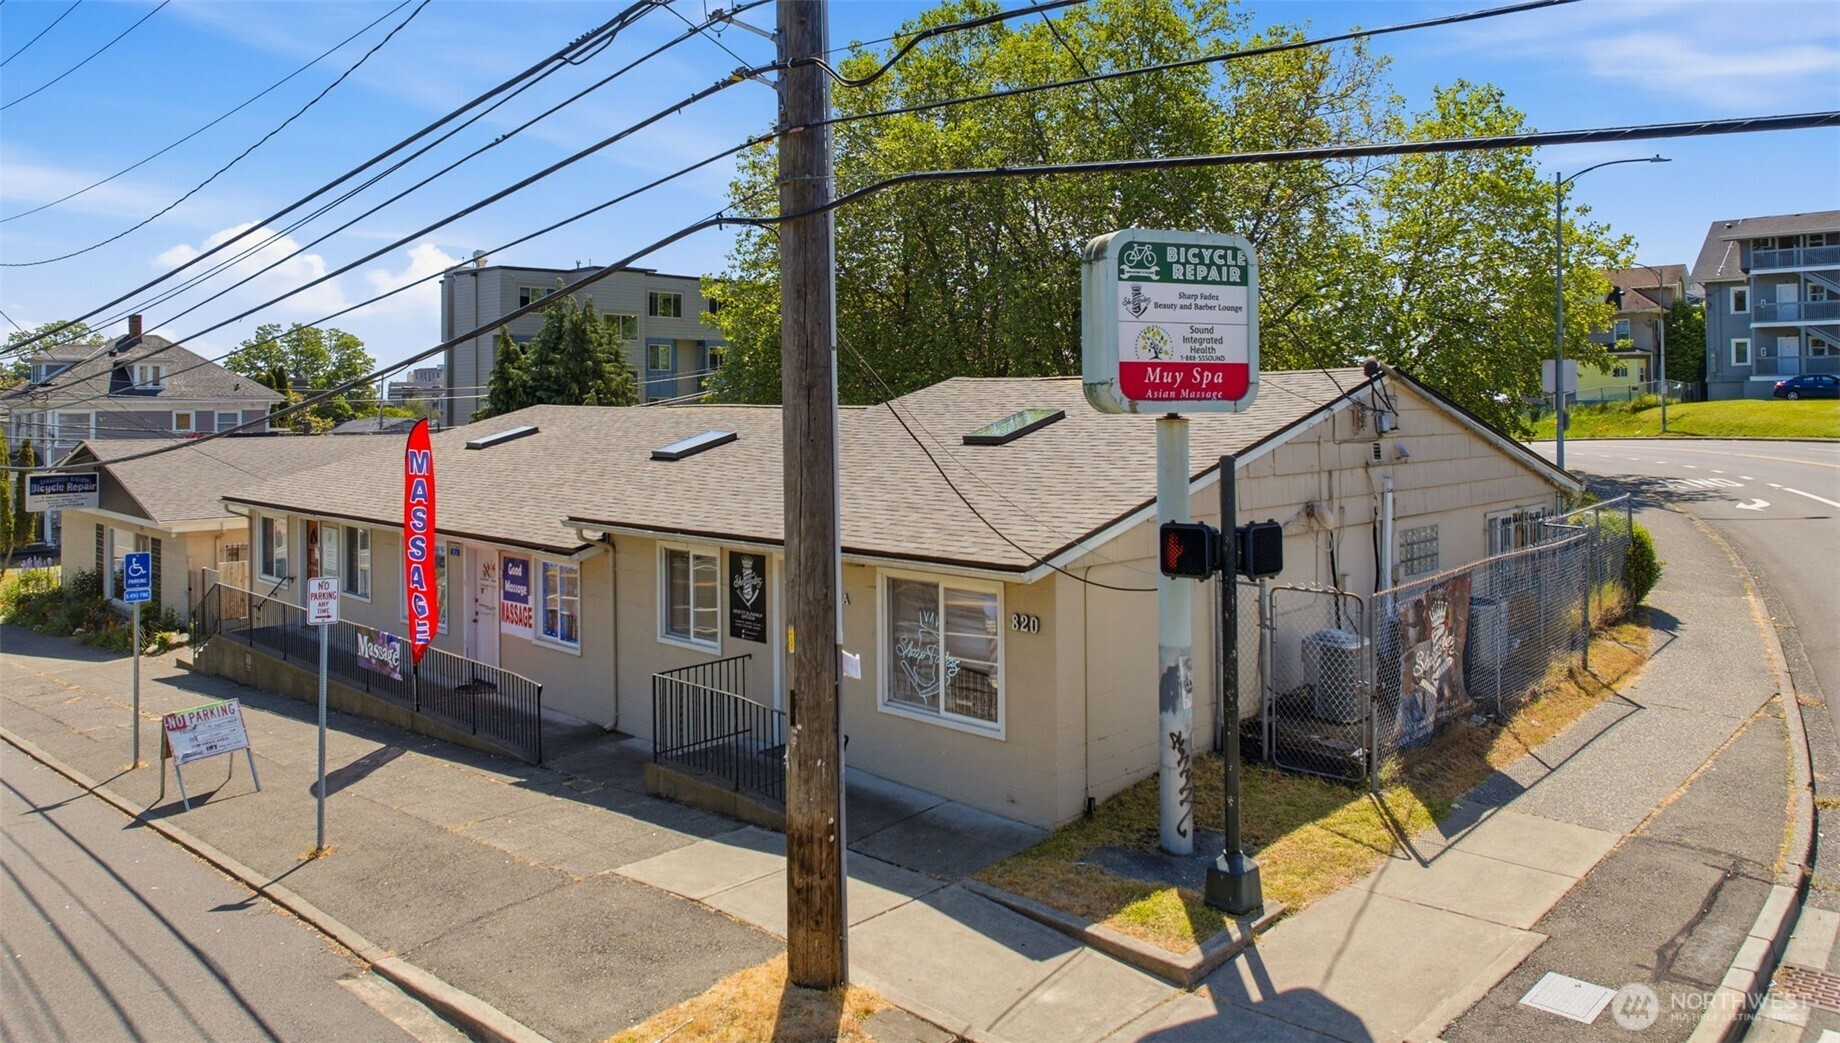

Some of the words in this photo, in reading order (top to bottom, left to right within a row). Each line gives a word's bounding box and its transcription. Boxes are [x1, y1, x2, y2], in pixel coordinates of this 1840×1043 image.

[1166, 247, 1246, 265] BICYCLE
[1172, 264, 1241, 282] REPAIR
[1178, 292, 1198, 301] Sharp
[1200, 293, 1219, 301] Fadez
[1154, 302, 1177, 311] Beauty
[1194, 303, 1216, 311] Barber
[1218, 304, 1243, 313] Lounge
[1189, 325, 1214, 334] Sound
[1182, 335, 1223, 346] Integrated
[1190, 346, 1216, 354] Health
[1144, 367, 1184, 388] Muy
[1191, 367, 1223, 388] Spa
[1145, 389, 1175, 399] Asian
[1180, 389, 1223, 401] Massage
[31, 482, 64, 494] Bicycle
[66, 482, 97, 492] Repair
[408, 450, 431, 644] MASSAGE
[508, 562, 522, 576] Good
[317, 581, 330, 591] NO
[504, 580, 528, 597] Massage
[310, 591, 337, 601] PARKING
[501, 601, 532, 629] MASSAGE
[1011, 613, 1040, 634] 820
[357, 634, 400, 668] Massage
[167, 714, 183, 729] NO
[189, 704, 235, 723] PARKING
